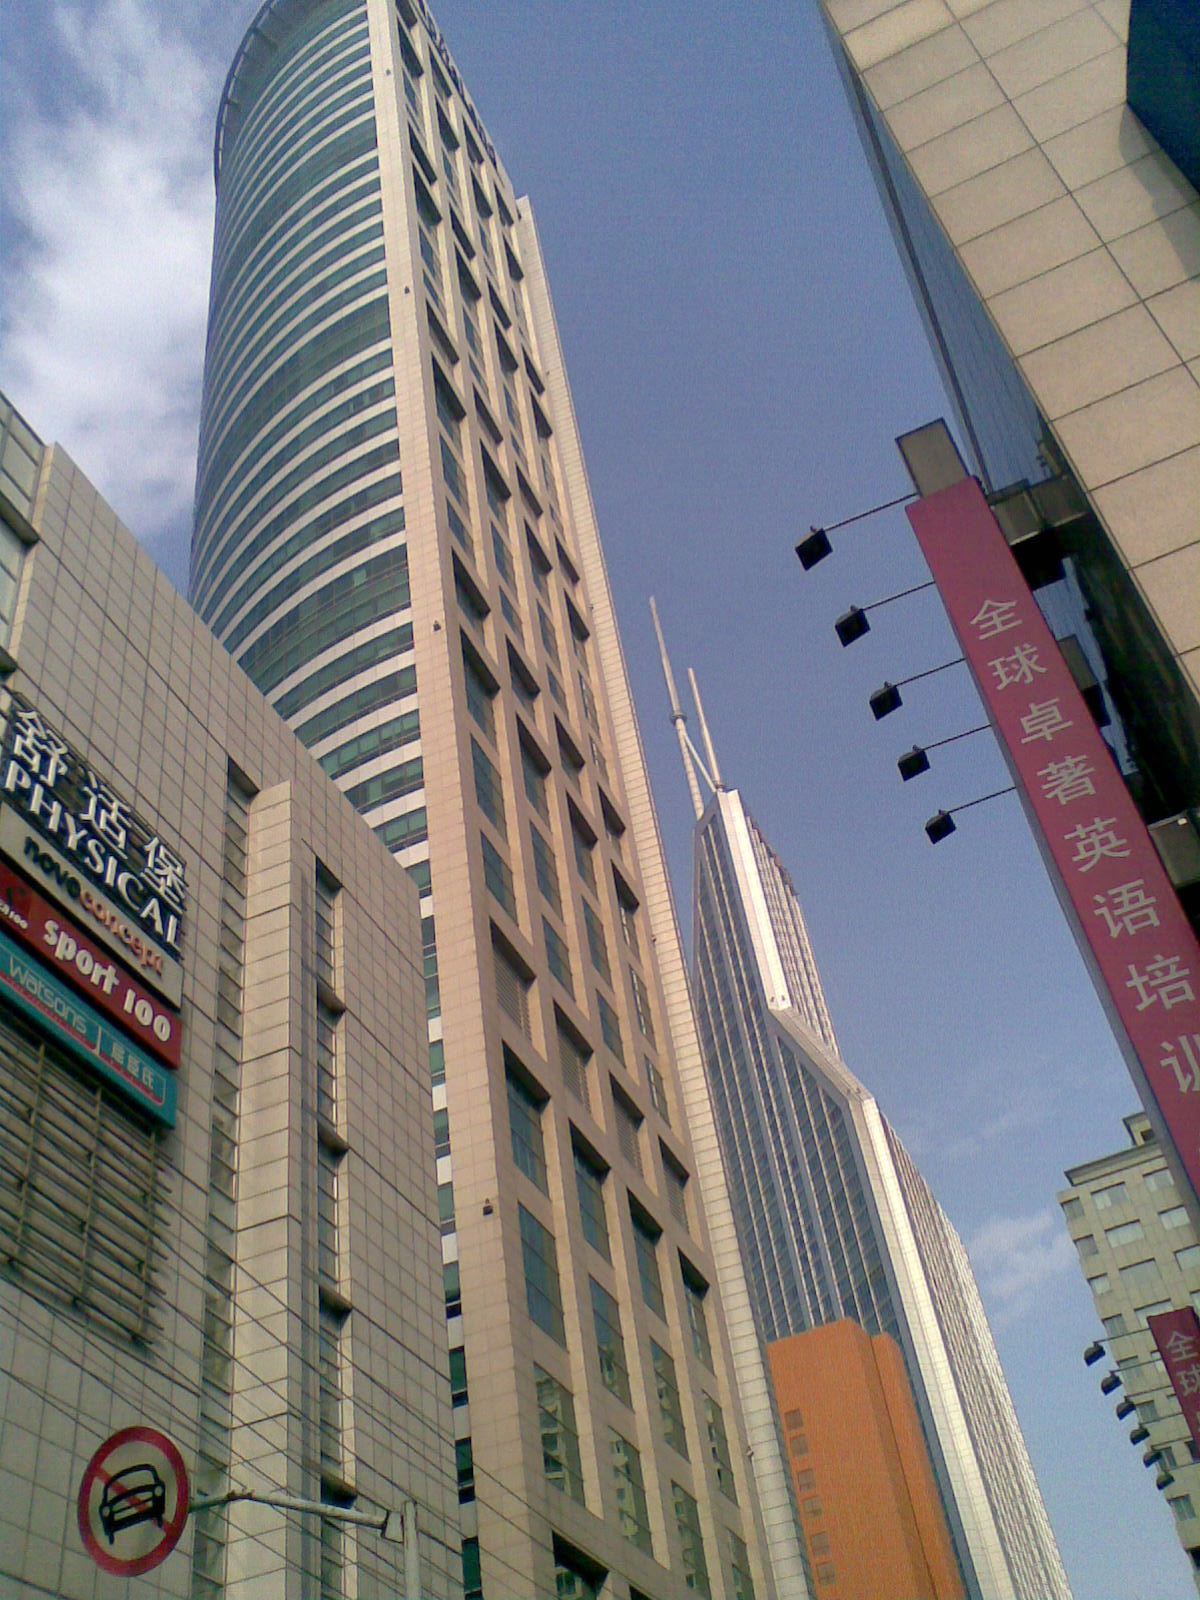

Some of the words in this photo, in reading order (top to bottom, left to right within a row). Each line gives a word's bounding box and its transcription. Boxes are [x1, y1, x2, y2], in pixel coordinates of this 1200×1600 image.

[5, 760, 182, 954] PHYSICAL
[14, 710, 186, 915] 舒适堡
[969, 598, 1200, 1094] 全球卓著英语培训
[44, 919, 120, 995] sport
[123, 988, 171, 1042] 100
